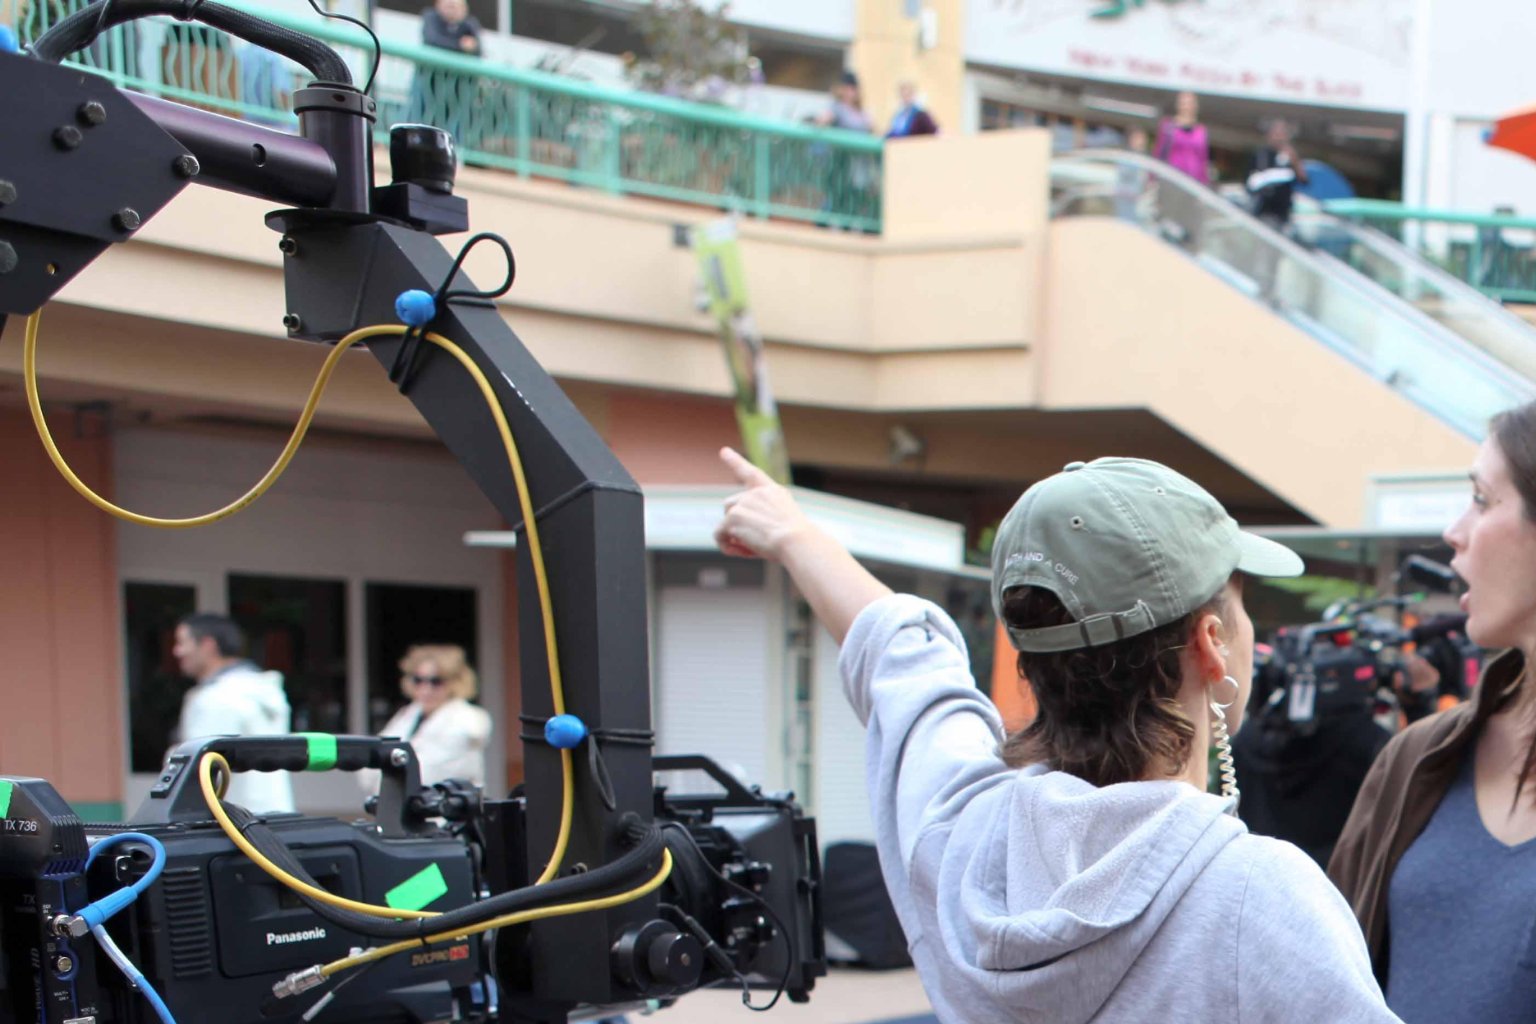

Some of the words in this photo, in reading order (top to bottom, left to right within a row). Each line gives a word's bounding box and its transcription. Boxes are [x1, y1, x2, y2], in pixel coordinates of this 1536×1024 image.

[1055, 562, 1080, 586] CURE
[4, 819, 16, 831] TX
[18, 820, 38, 832] 736
[266, 926, 326, 945] Panasonic
